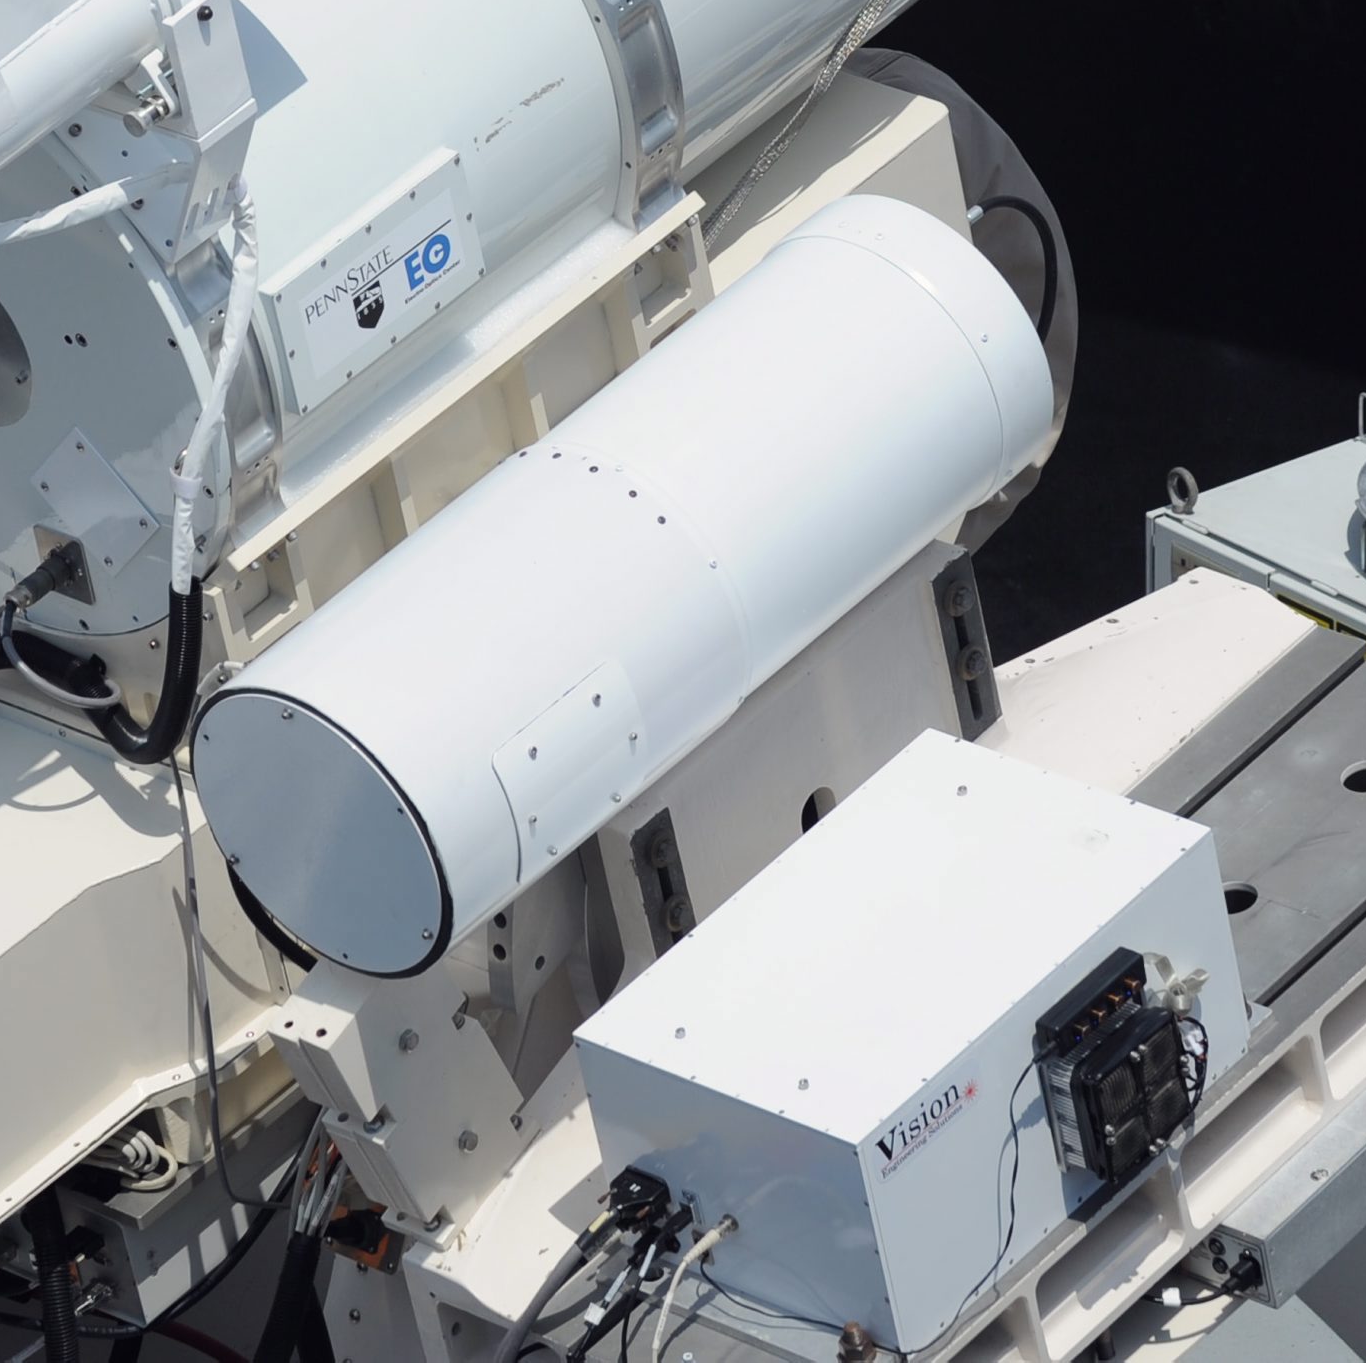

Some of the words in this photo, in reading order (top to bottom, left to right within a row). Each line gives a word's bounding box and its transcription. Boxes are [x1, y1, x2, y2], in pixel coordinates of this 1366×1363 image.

[874, 1084, 960, 1161] Vision
[880, 1136, 928, 1179] Engineering
[928, 1104, 963, 1138] Solutions
